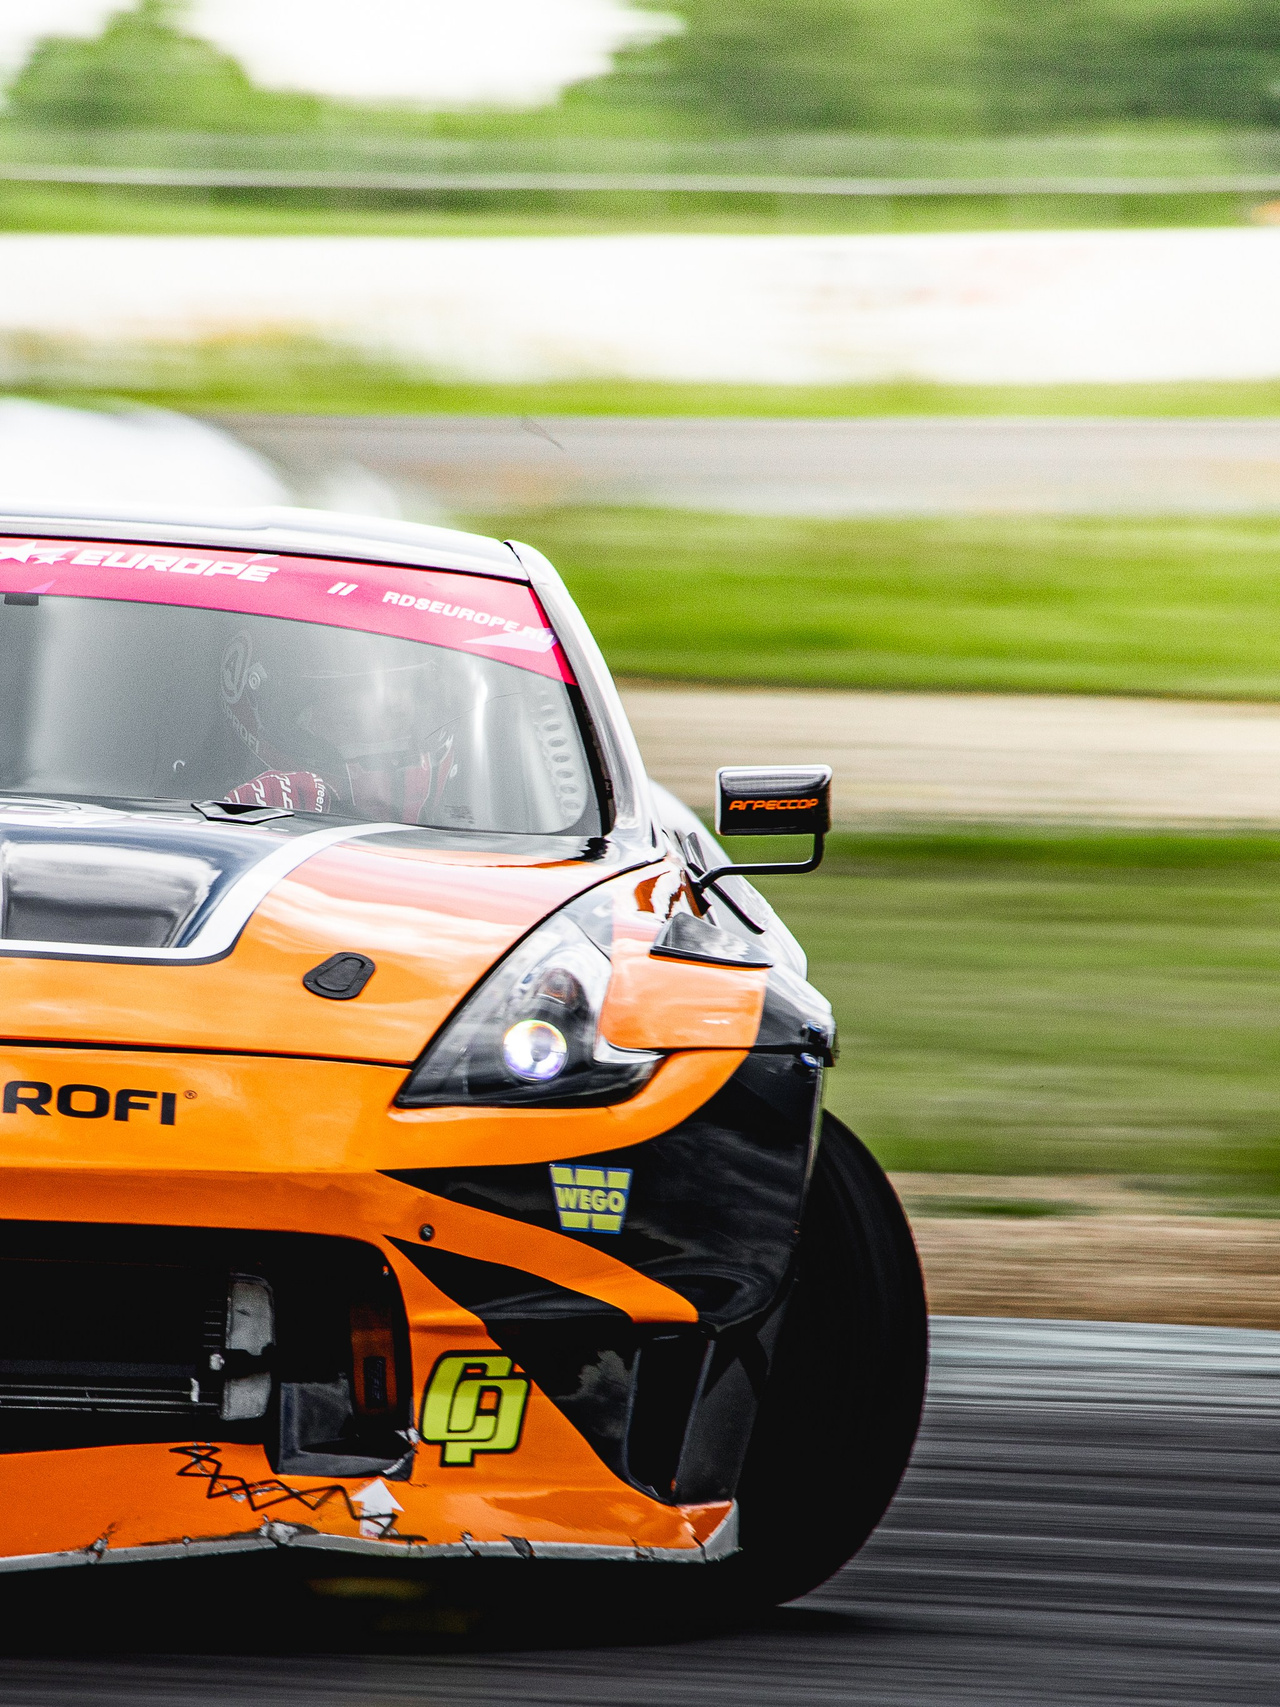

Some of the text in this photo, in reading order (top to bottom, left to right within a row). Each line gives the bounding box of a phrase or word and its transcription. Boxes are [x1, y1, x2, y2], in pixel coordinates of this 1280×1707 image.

[70, 549, 280, 583] EUROPE
[382, 591, 554, 644] RDSEUROPE.RU
[555, 1186, 627, 1213] WEGO
